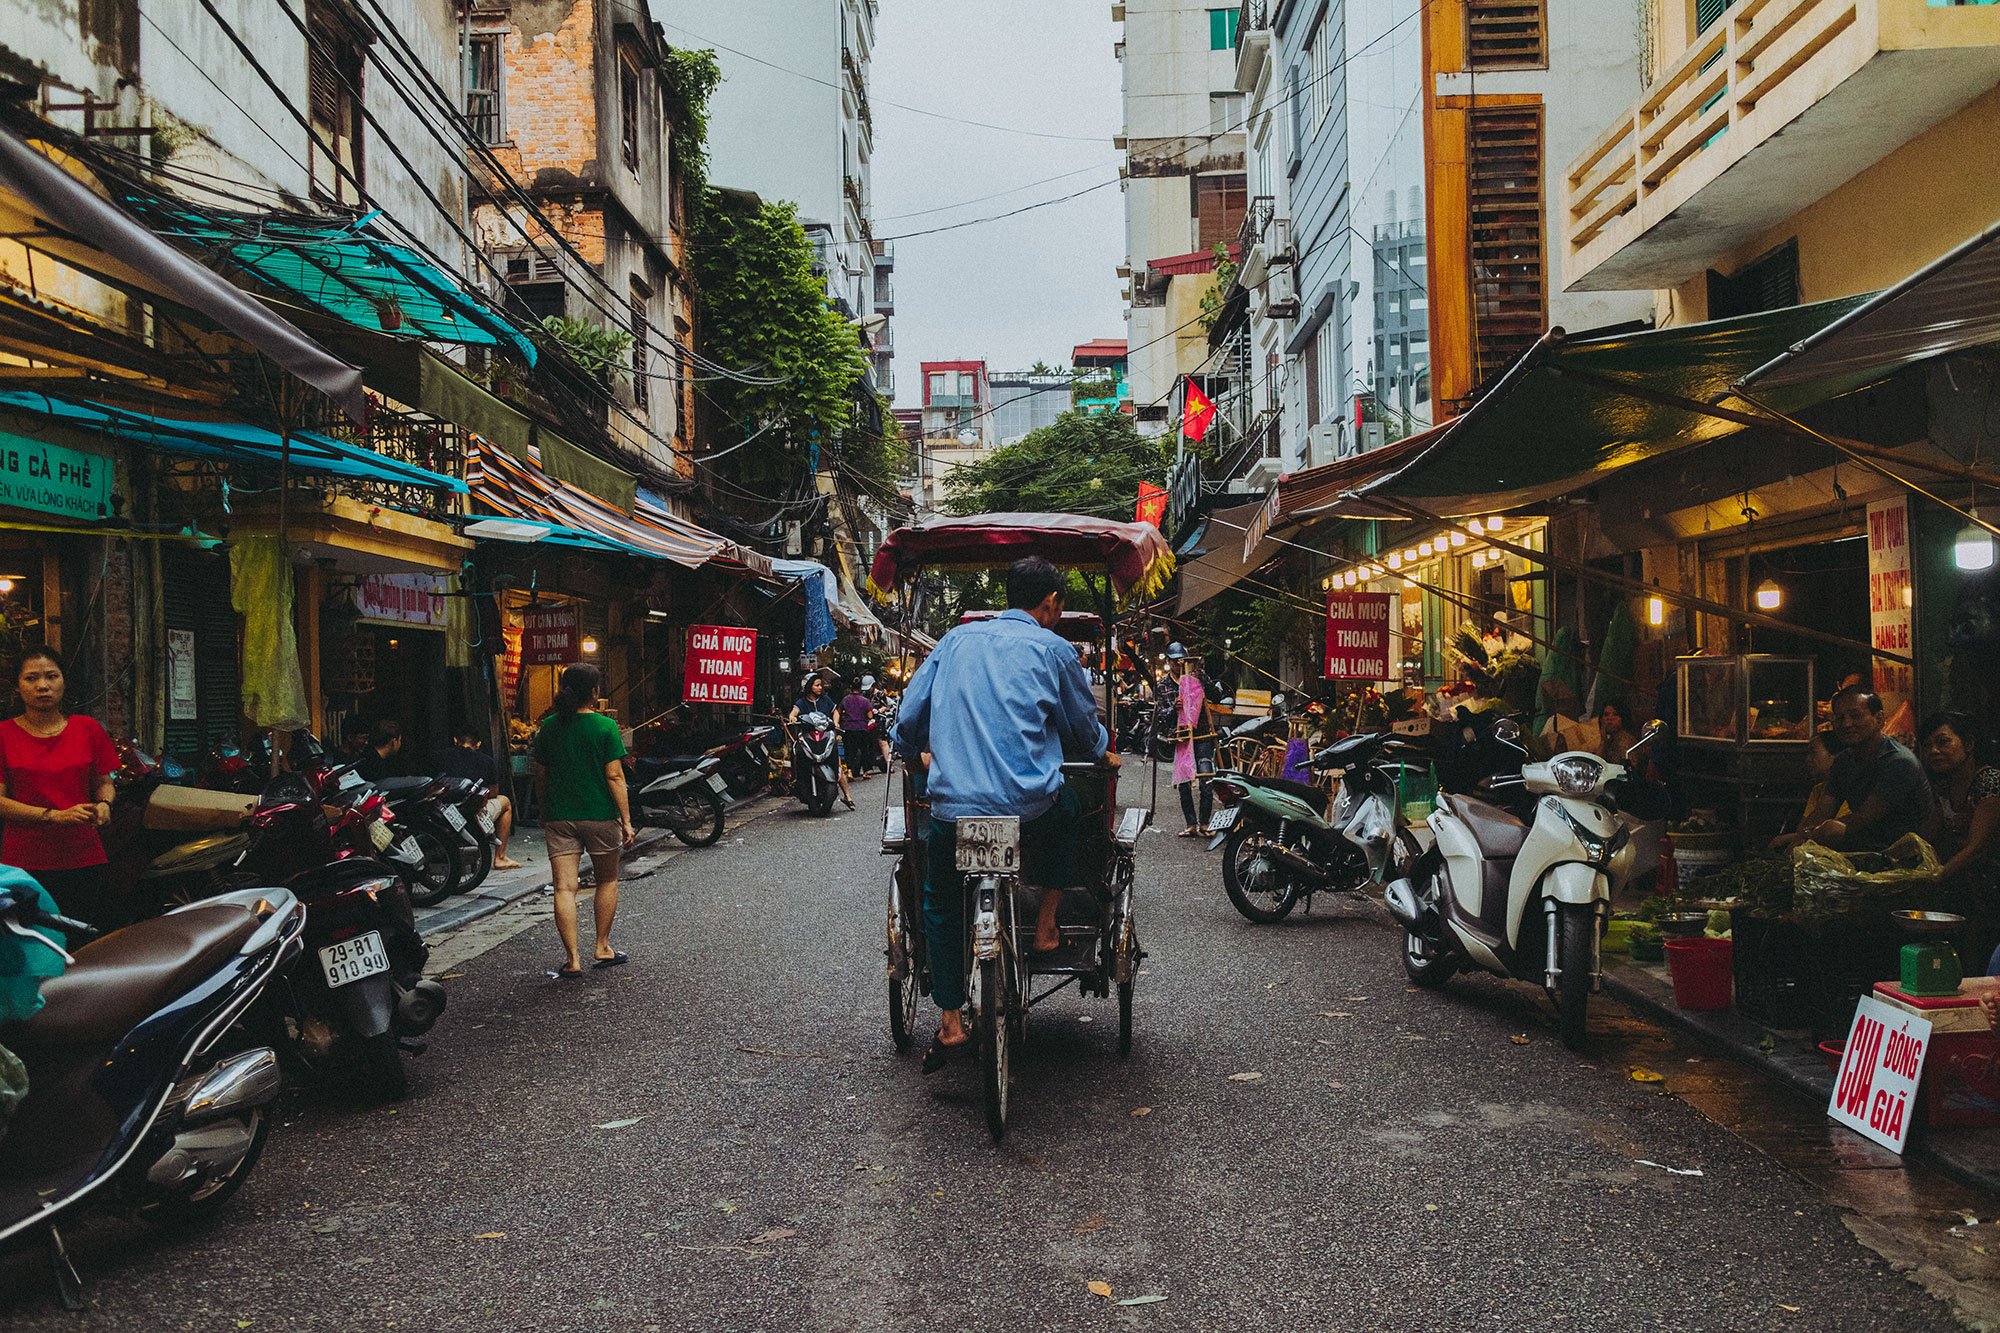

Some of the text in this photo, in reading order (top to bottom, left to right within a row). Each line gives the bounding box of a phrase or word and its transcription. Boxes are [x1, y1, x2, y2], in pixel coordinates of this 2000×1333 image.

[29, 448, 51, 480] CÀ
[60, 458, 91, 488] PHÊ
[37, 488, 63, 508] LÒNG
[65, 496, 95, 513] KHÁCH
[1330, 595, 1387, 624] CHẢ MỰC
[692, 628, 752, 655] CHẢ MỰC
[1336, 630, 1378, 648] THOAN
[1875, 618, 1908, 650] HÀNG BÈ
[699, 658, 743, 677] THOAN
[1330, 657, 1384, 679] HẠ LONG
[690, 682, 748, 702] HẠ LONG
[328, 936, 373, 965] 29-B1
[329, 953, 384, 984] 910.90
[1836, 1014, 1885, 1120] CUA
[1870, 1090, 1908, 1141] GIÃ
